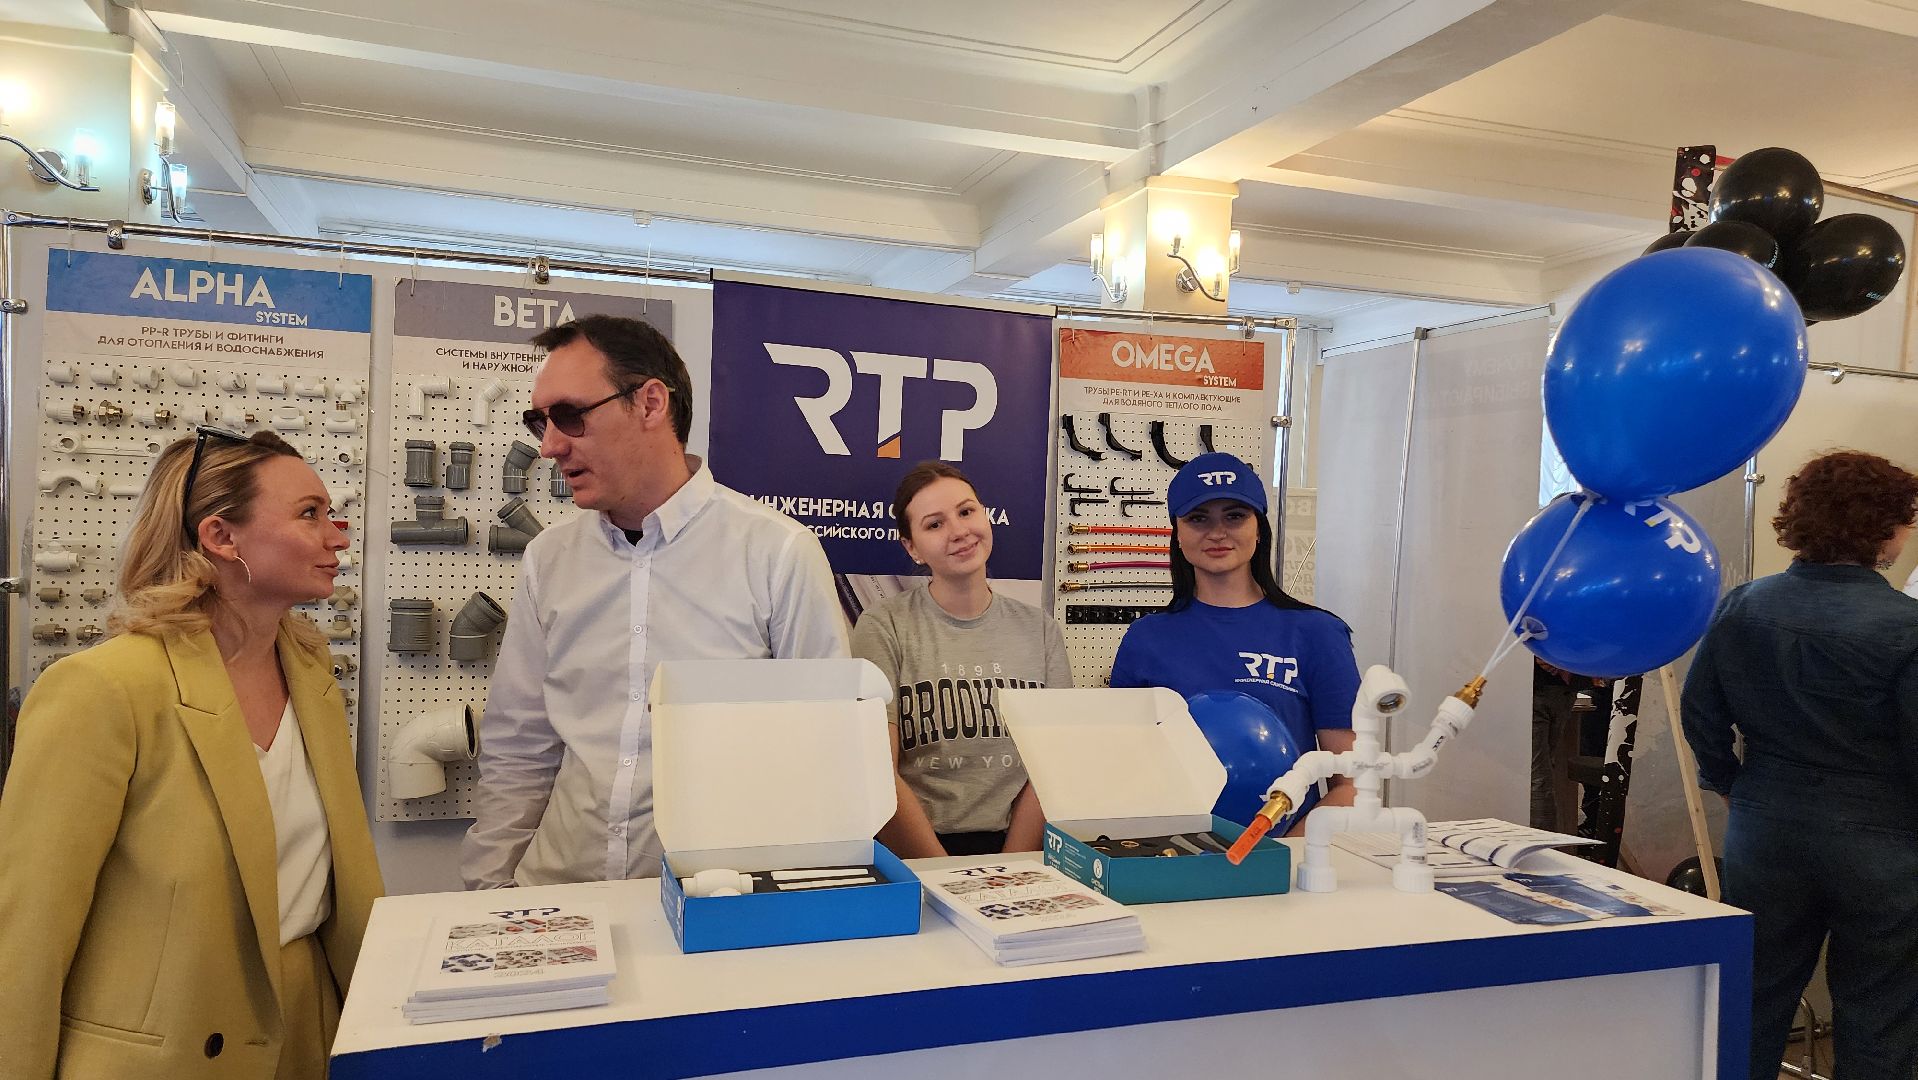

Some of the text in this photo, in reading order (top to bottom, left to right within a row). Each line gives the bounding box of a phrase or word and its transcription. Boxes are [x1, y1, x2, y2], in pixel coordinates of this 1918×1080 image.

[130, 267, 275, 308] ALPHA
[255, 310, 308, 326] SYSTEM
[173, 328, 212, 341] ТРУБЫ
[215, 332, 224, 341] И
[227, 332, 284, 345] ФИТИНГИ
[97, 335, 324, 360] ДЛЯ ОТОПЛЕНИЯ И ВОДОСНАБЖЕНИЯ
[435, 347, 547, 363] СИСТЕМЫ ВНУТРЕННЕ
[1111, 340, 1215, 374] OMEGA
[462, 360, 470, 370] И
[472, 360, 534, 374] НАРУЖНОЙ
[1203, 375, 1237, 388] SYSTEM
[763, 342, 998, 462] RTP
[1084, 386, 1109, 396] ТРУБЫ
[1133, 389, 1140, 398] И
[1165, 391, 1171, 400] И
[1172, 392, 1241, 404] КОМПЛЕКТУЮЩИЕ
[1102, 397, 1223, 412] ДЛЯ ВОДЯНОГО ТЕПЛОГО ПОЛА
[1198, 471, 1237, 487] RTP
[941, 662, 1002, 677] 1898
[1238, 652, 1299, 684] RTP
[899, 678, 1045, 751] BROOK
[913, 754, 1021, 770] NEW YO
[949, 865, 1008, 877] RTP
[489, 907, 560, 919] RTP
